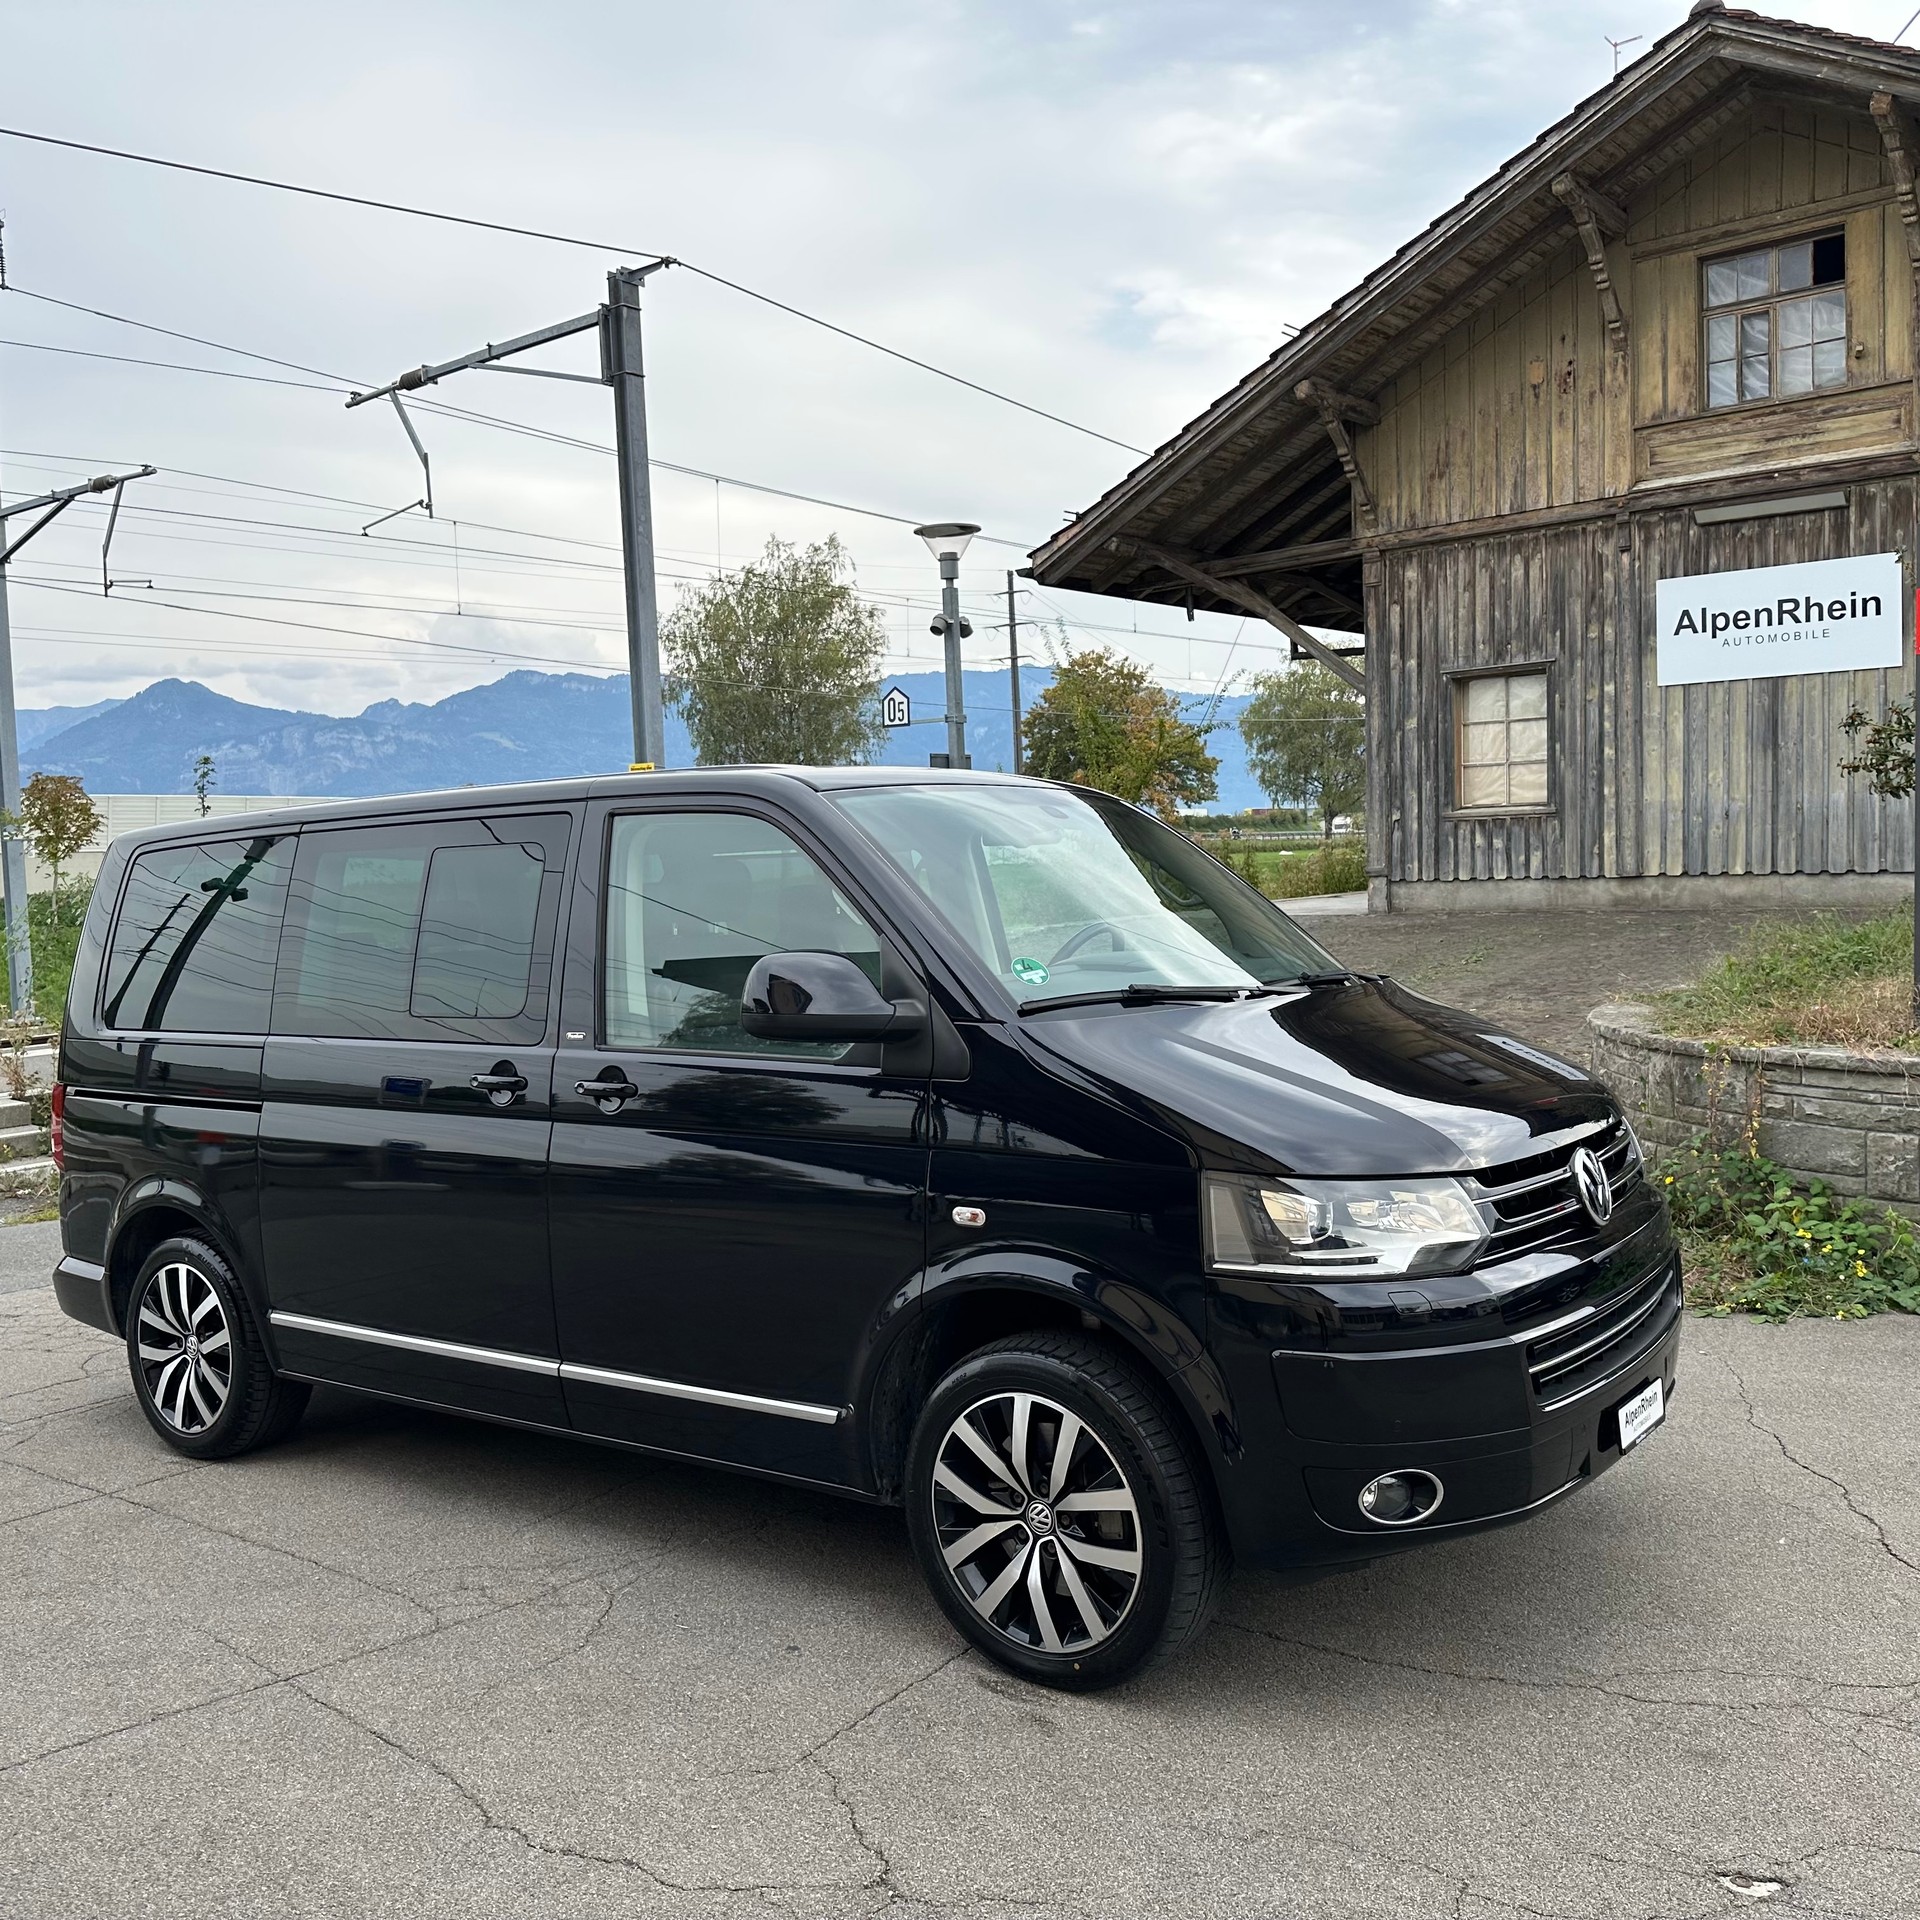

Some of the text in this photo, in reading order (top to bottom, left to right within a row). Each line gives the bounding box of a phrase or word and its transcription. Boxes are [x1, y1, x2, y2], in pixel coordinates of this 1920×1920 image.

[1673, 591, 1882, 639] AlpenRhein
[1722, 628, 1831, 647] AUTOMOBILE
[888, 697, 904, 722] 05
[1624, 1390, 1658, 1429] AlpenRhein
